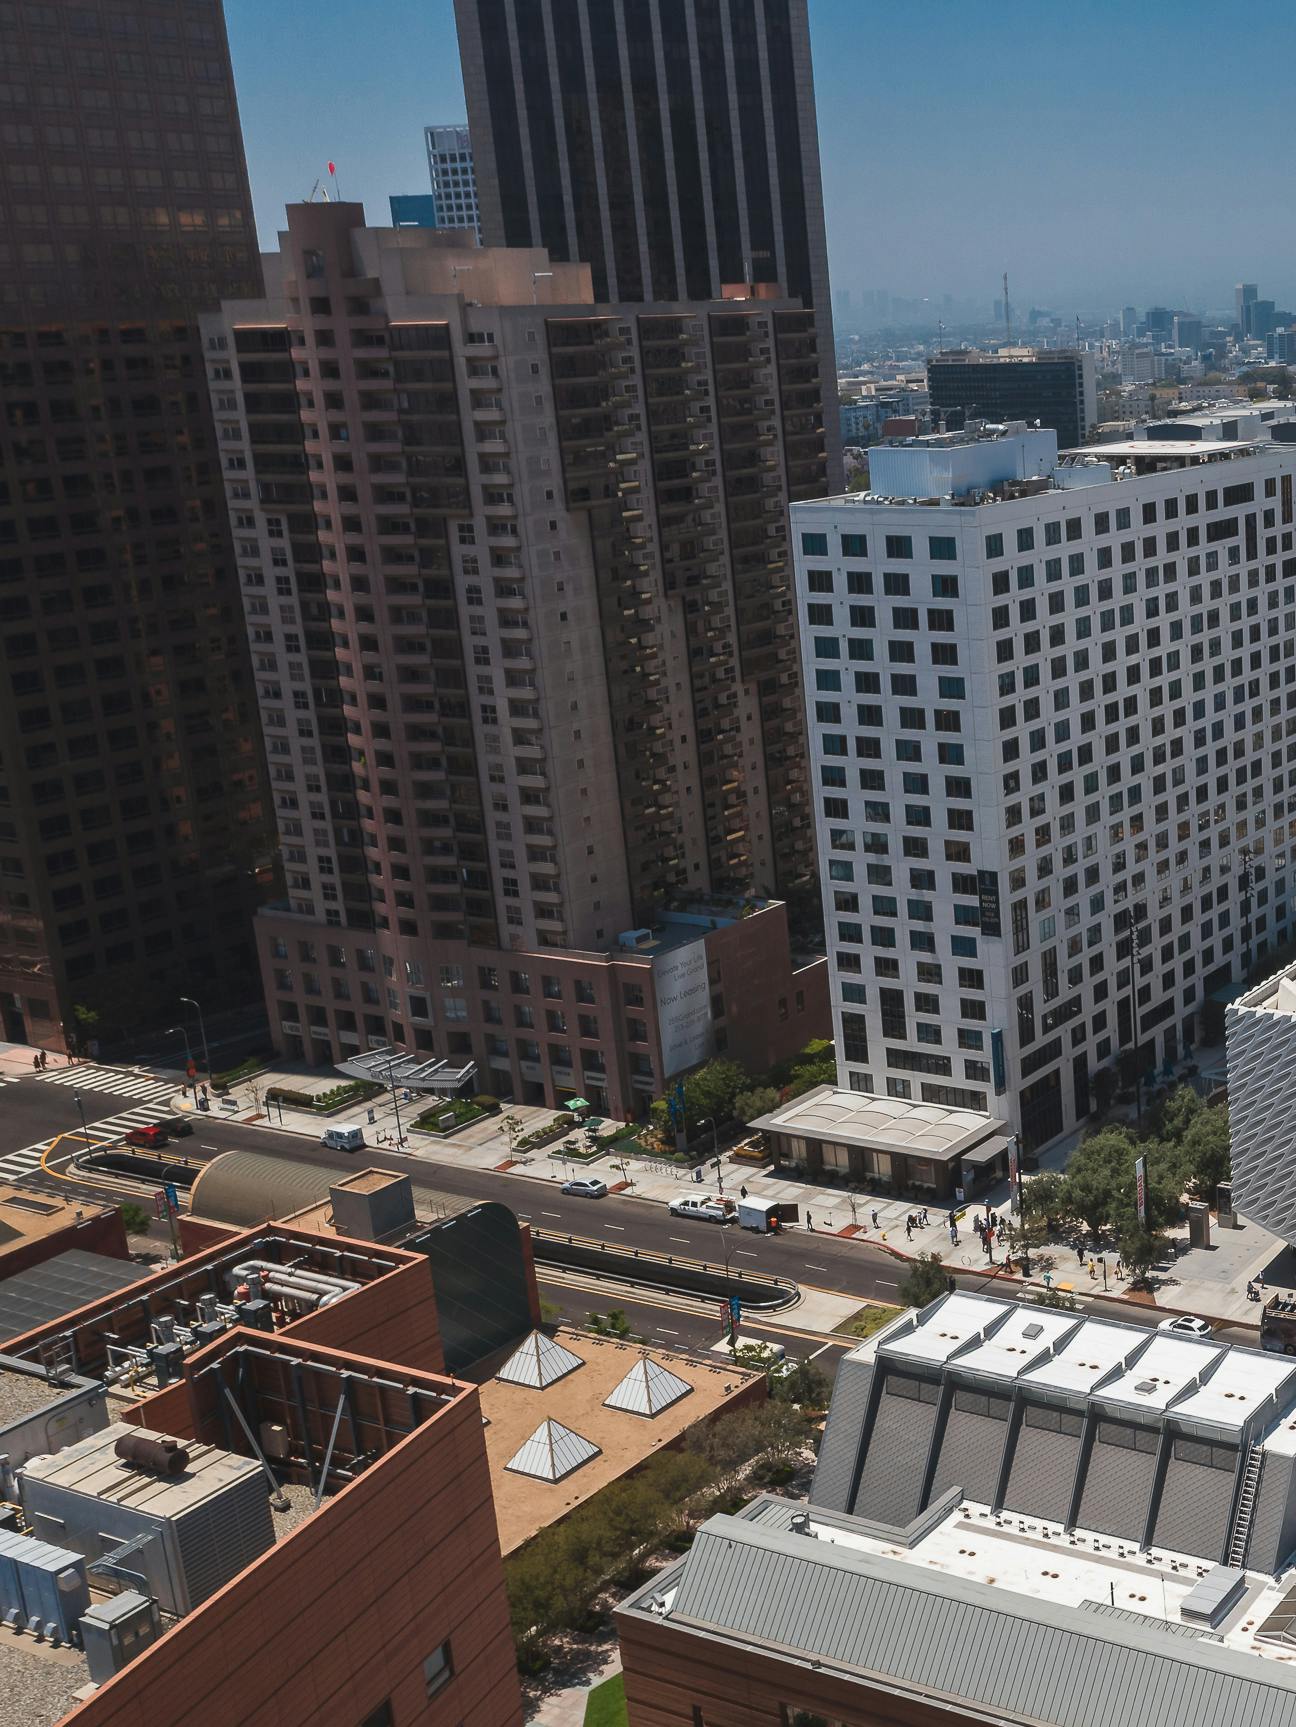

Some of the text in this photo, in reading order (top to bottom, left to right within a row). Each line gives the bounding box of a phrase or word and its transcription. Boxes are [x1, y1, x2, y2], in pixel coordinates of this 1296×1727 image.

[982, 894, 996, 902] RENT
[660, 982, 706, 1007] Now Leasing
